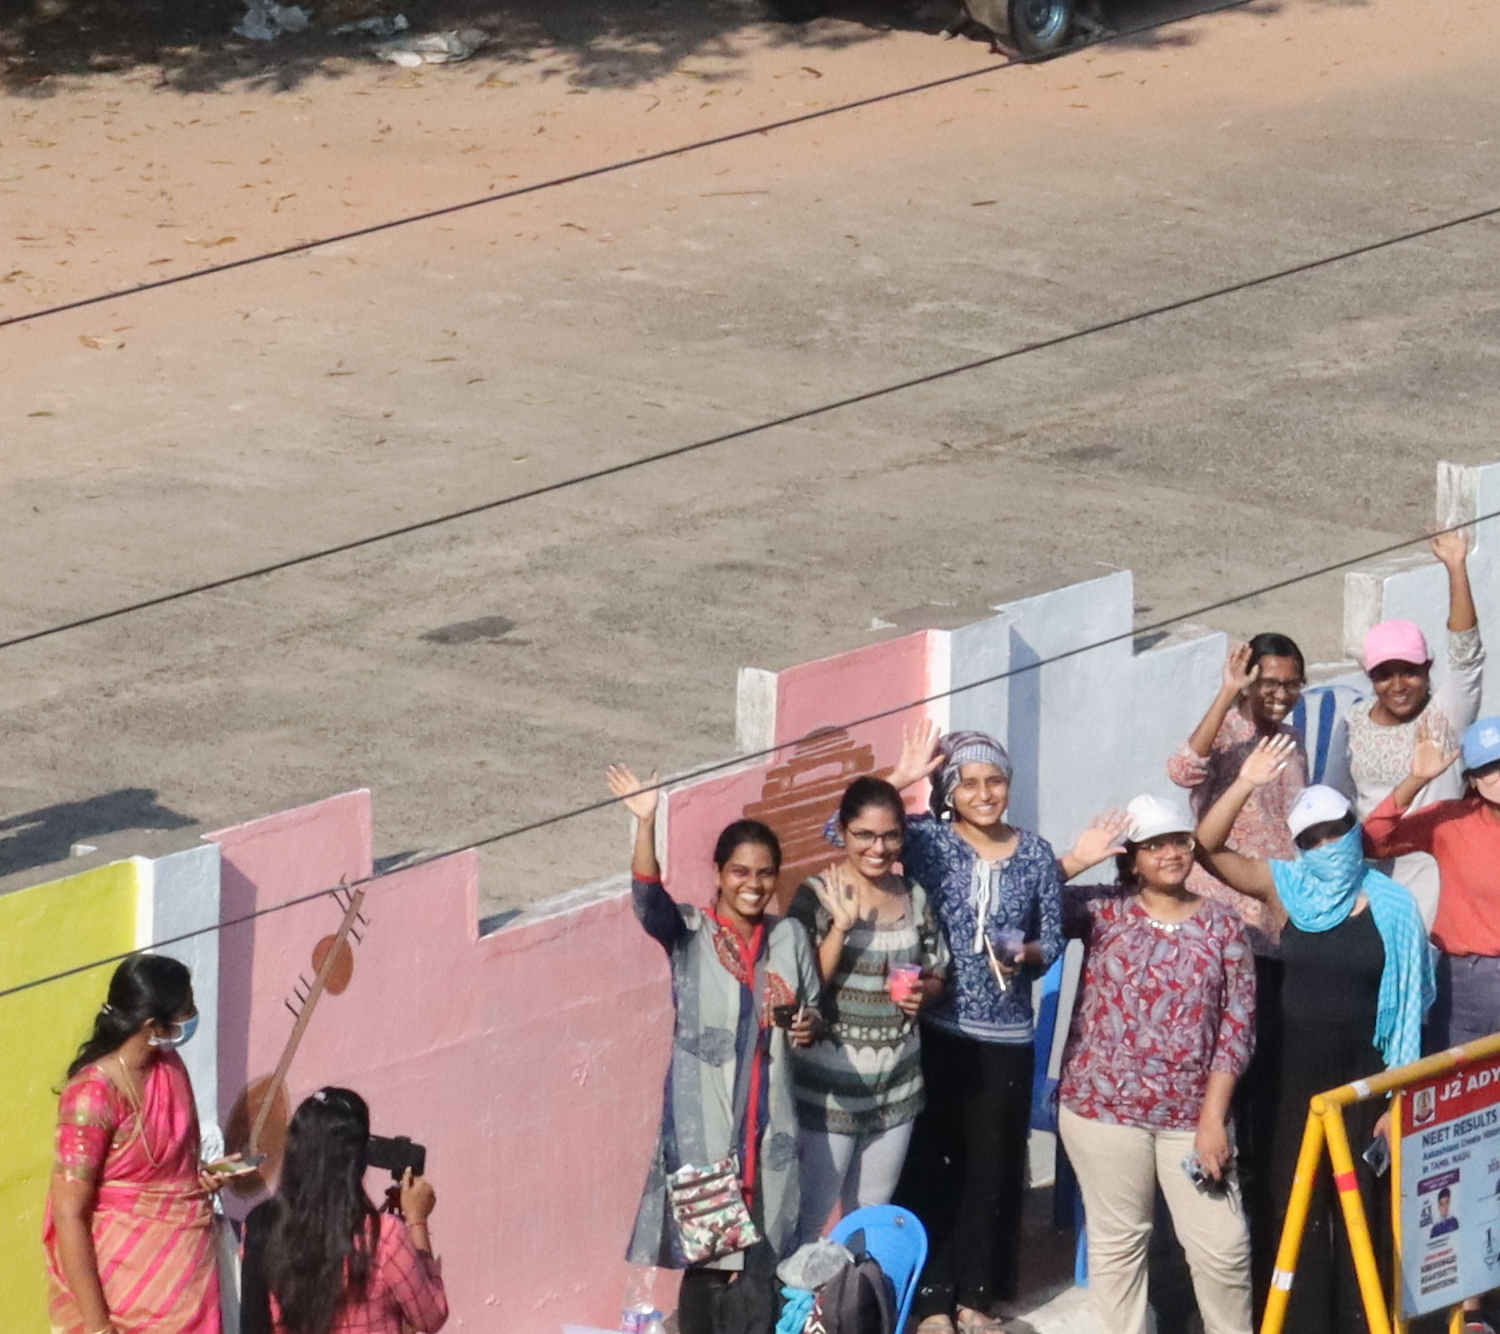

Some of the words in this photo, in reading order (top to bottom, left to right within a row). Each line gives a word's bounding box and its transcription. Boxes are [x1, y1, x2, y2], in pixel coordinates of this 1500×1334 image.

[1439, 1079, 1462, 1102] J2
[1422, 1127, 1451, 1147] NEET
[1453, 1109, 1497, 1137] RESULTS
